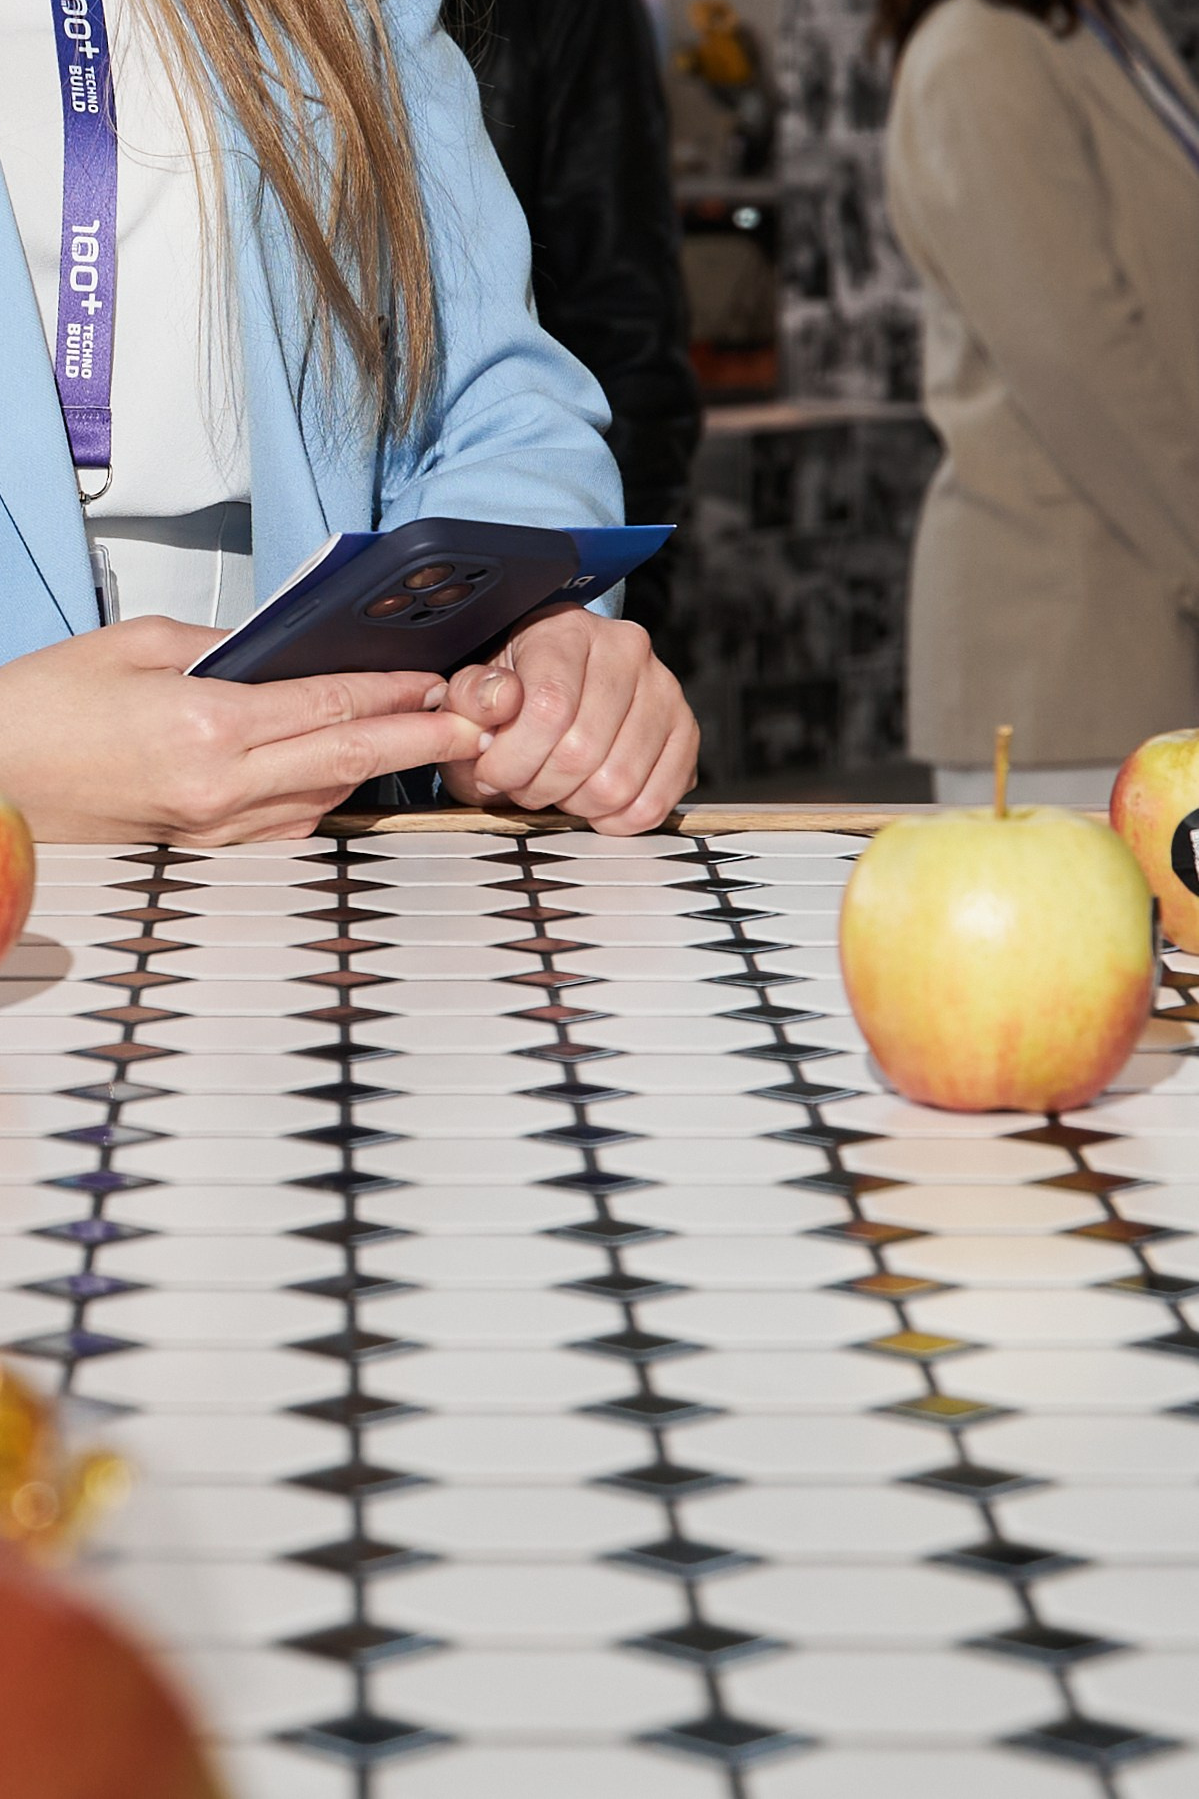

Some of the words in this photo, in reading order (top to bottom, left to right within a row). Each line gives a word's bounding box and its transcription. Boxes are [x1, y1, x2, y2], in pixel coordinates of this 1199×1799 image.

[68, 64, 86, 113] BUILD
[84, 65, 99, 114] TECHNO
[69, 219, 103, 316] 100+
[65, 322, 81, 379] BUILD
[80, 323, 94, 379] TECHNO
